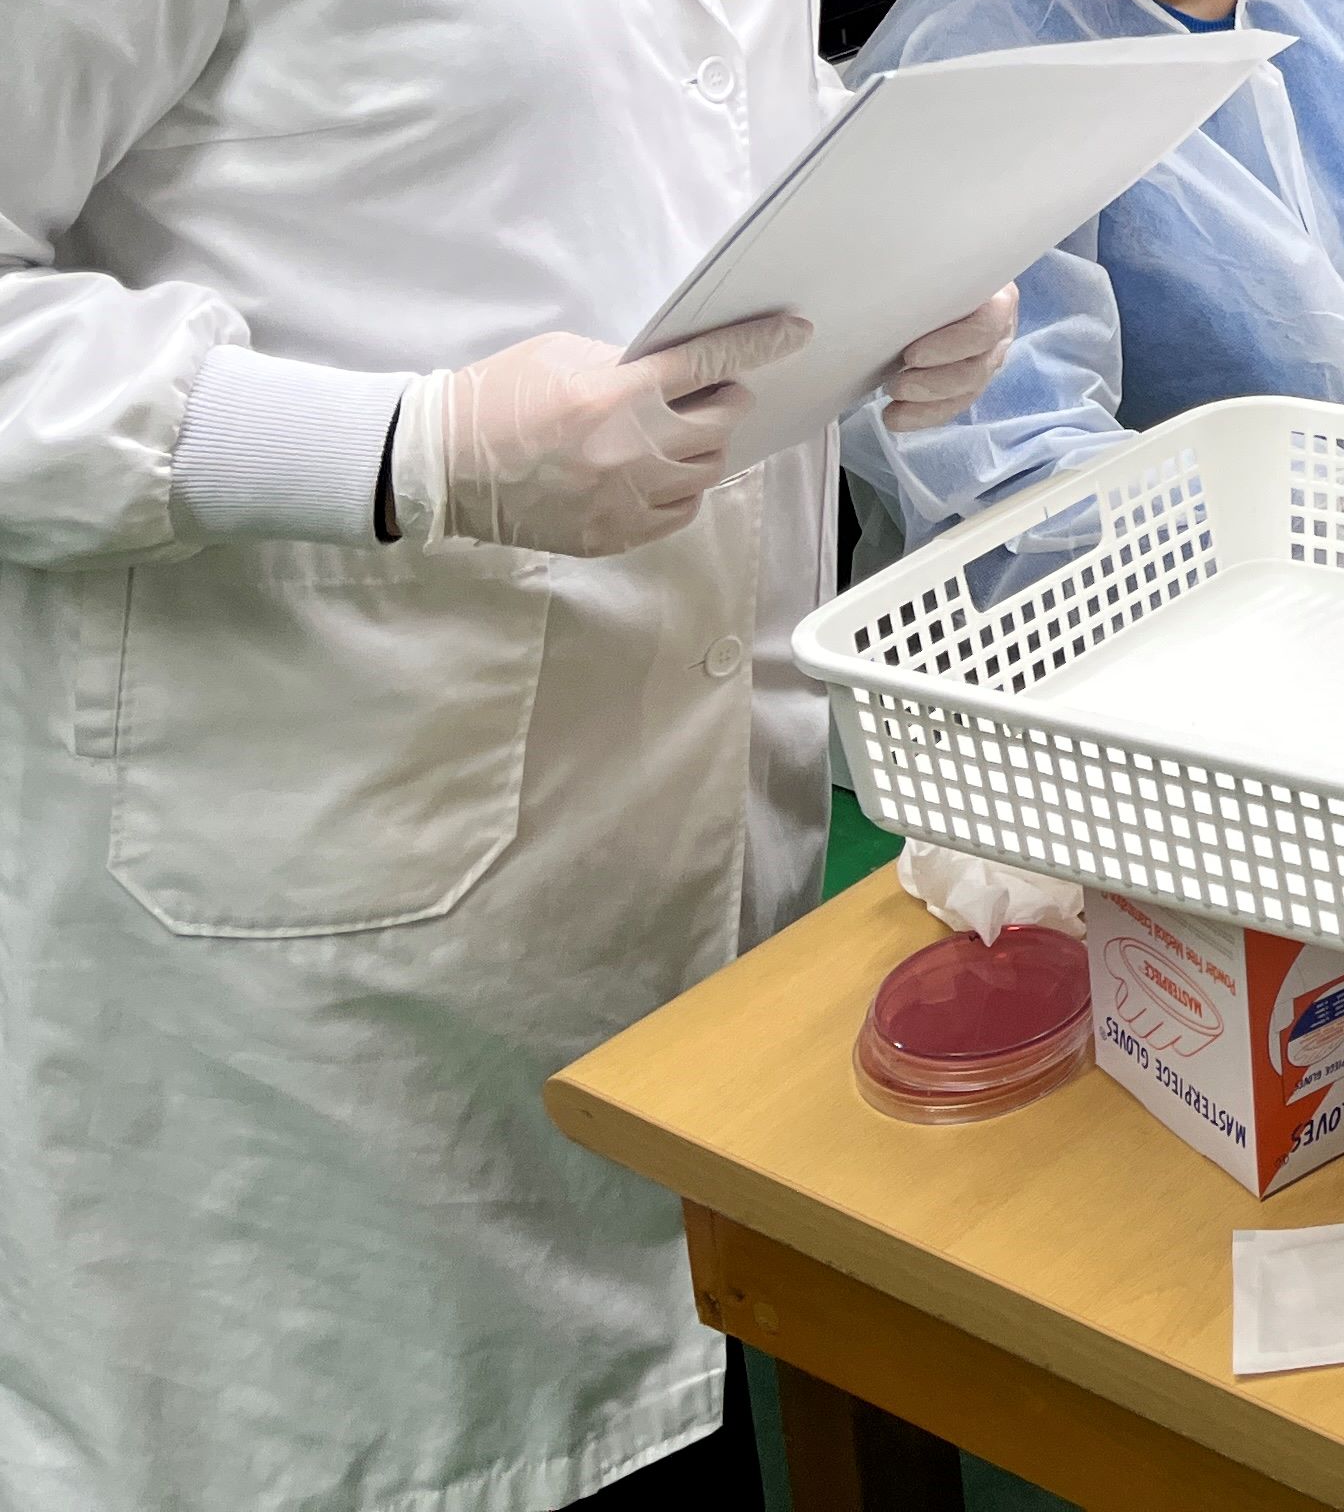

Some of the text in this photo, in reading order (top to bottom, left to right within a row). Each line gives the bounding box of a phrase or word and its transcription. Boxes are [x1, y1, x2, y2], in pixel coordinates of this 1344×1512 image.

[1143, 960, 1203, 1019] MASTERPIECE
[1105, 1016, 1247, 1149] MASTERPIECE GLOVES
